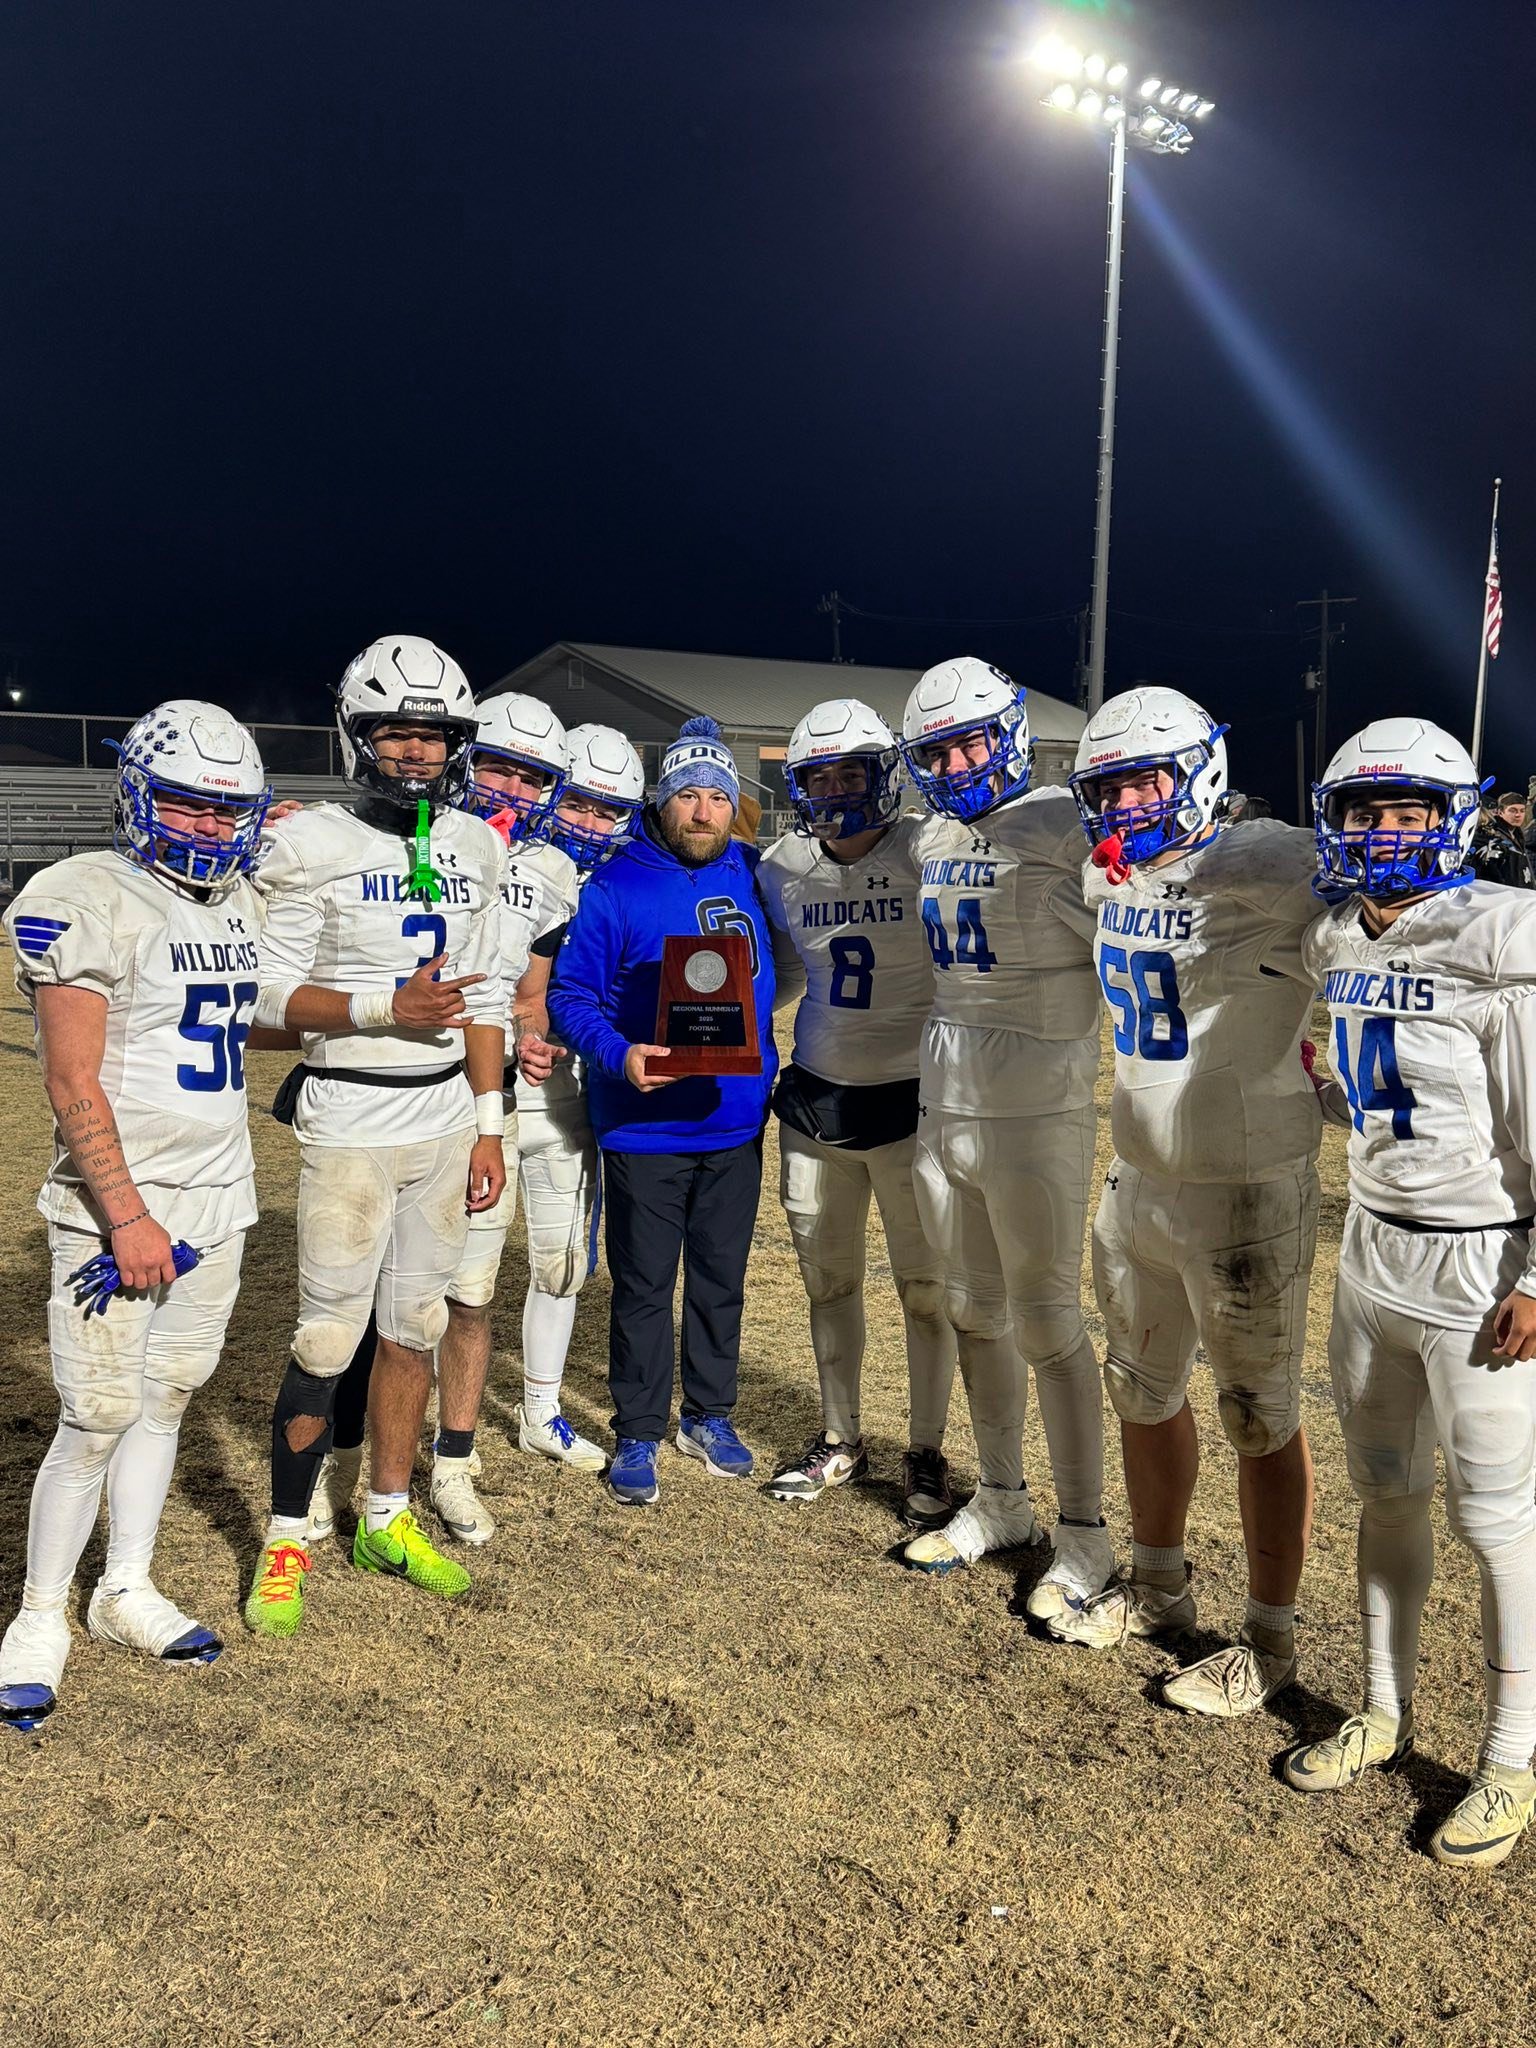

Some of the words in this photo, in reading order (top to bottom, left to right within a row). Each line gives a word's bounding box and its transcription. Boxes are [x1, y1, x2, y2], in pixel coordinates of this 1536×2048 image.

[404, 700, 445, 712] Riddell
[923, 715, 955, 732] Riddell
[811, 744, 841, 755] Riddell
[1089, 750, 1122, 765] Riddell
[203, 776, 240, 788] Riddell
[1358, 763, 1403, 774] Riddell
[588, 779, 617, 793] Riddell
[922, 860, 998, 887] WILDCATS
[802, 898, 903, 928] WILDCATS
[1101, 900, 1192, 940] WILDCATS
[922, 897, 998, 973] 44
[169, 941, 258, 972] WILDCATS
[395, 914, 446, 989] 3
[829, 936, 876, 1009] 8
[1100, 942, 1188, 1060] 58
[1326, 971, 1434, 1011] WILDCATS
[1336, 1017, 1418, 1140] 14
[60, 1099, 92, 1120] GOD
[71, 1126, 110, 1147] Toughest
